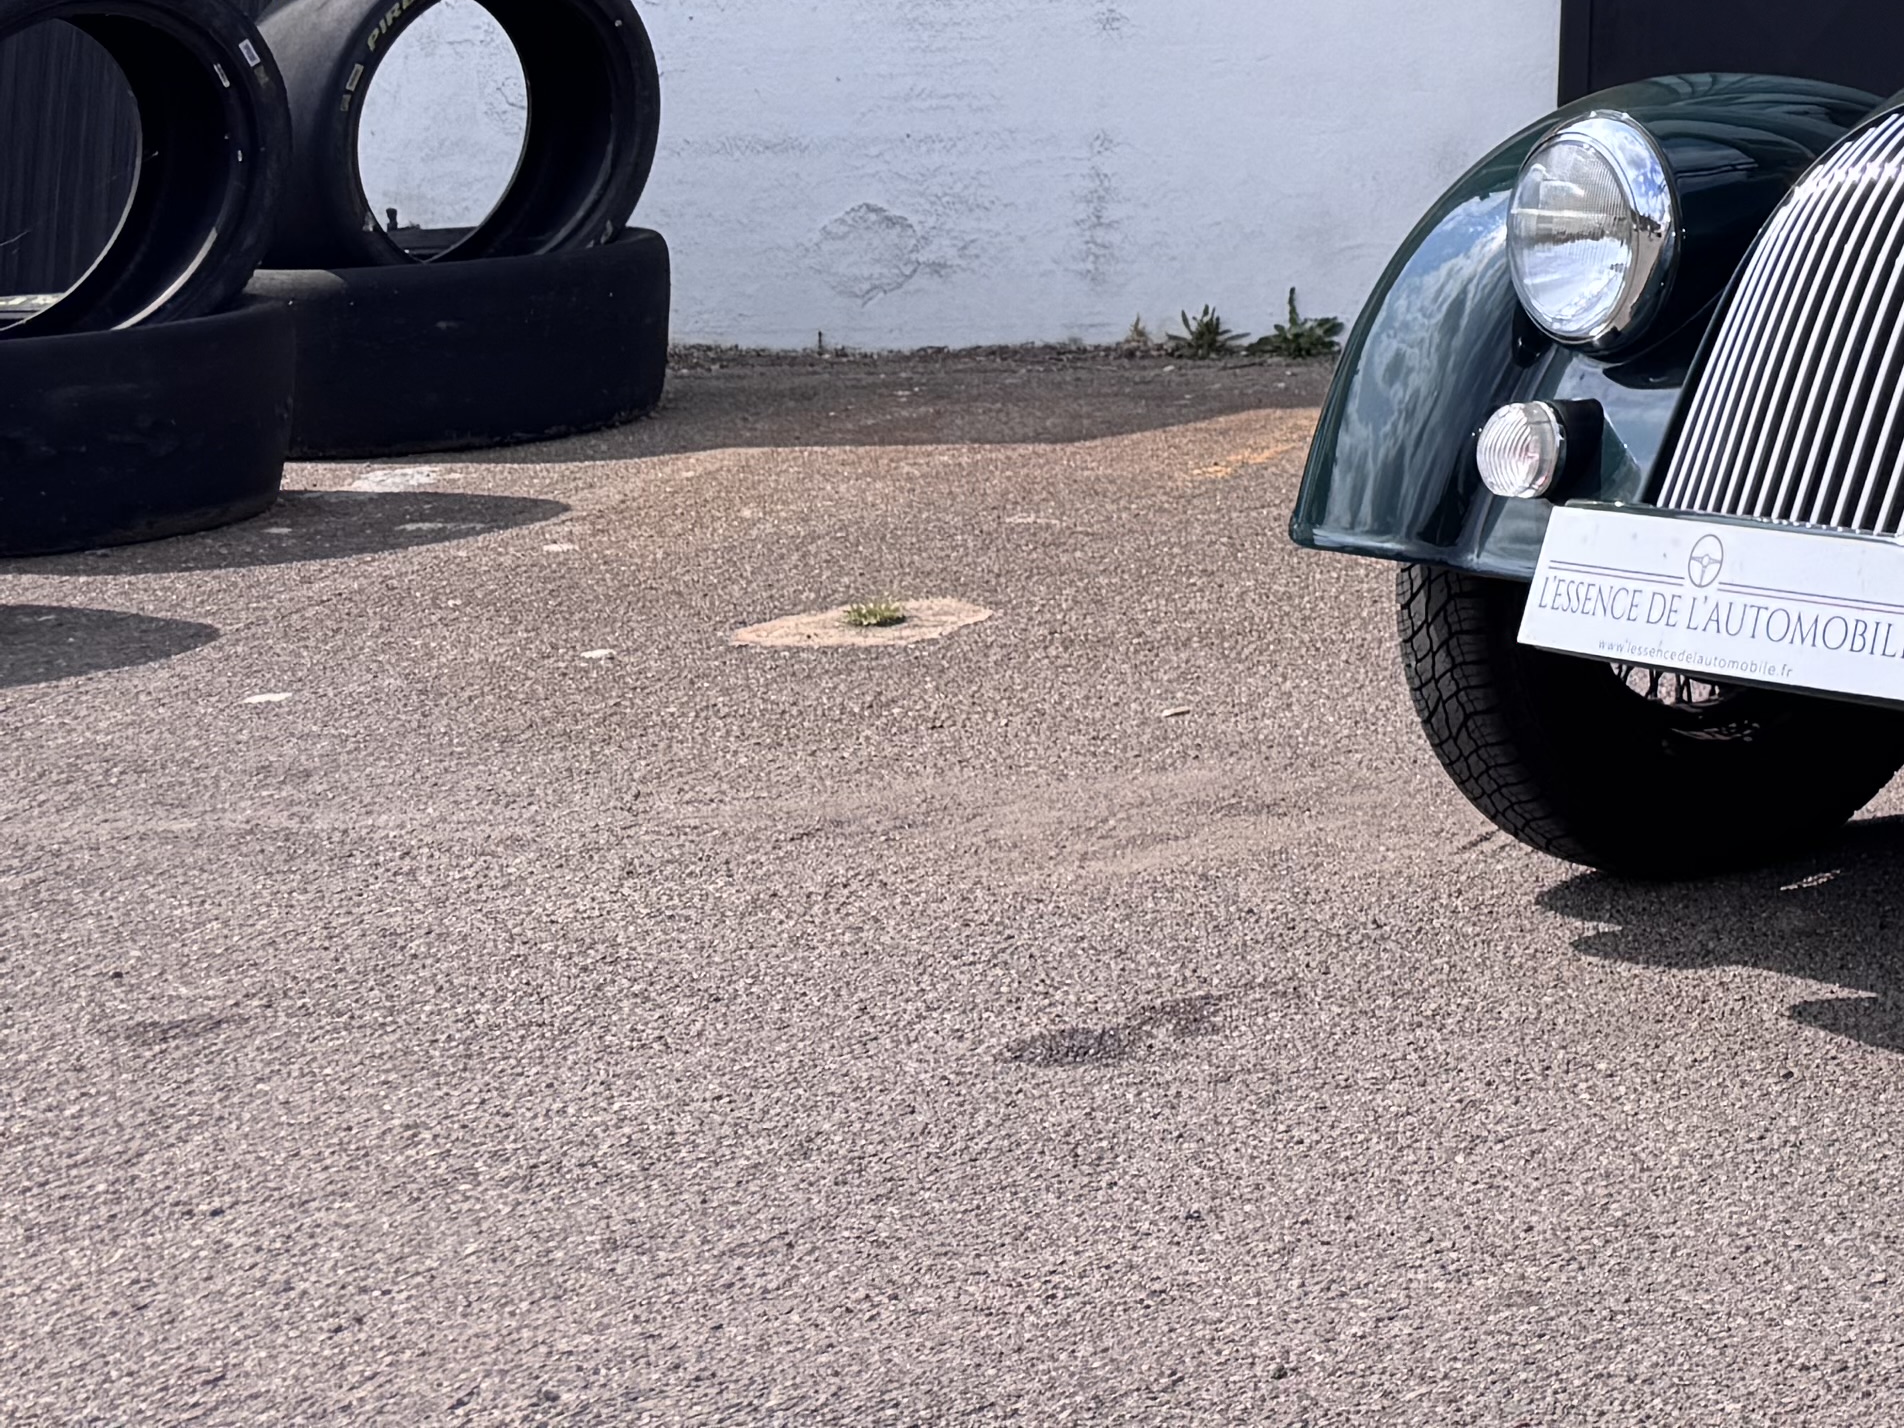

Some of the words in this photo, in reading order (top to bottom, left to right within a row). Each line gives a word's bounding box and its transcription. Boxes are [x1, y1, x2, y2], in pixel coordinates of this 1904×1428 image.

[1538, 576, 1643, 621] L'ESSENCE
[1646, 592, 1682, 627] DE
[1598, 639, 1793, 678] www.lessencedelautomobile.fr
